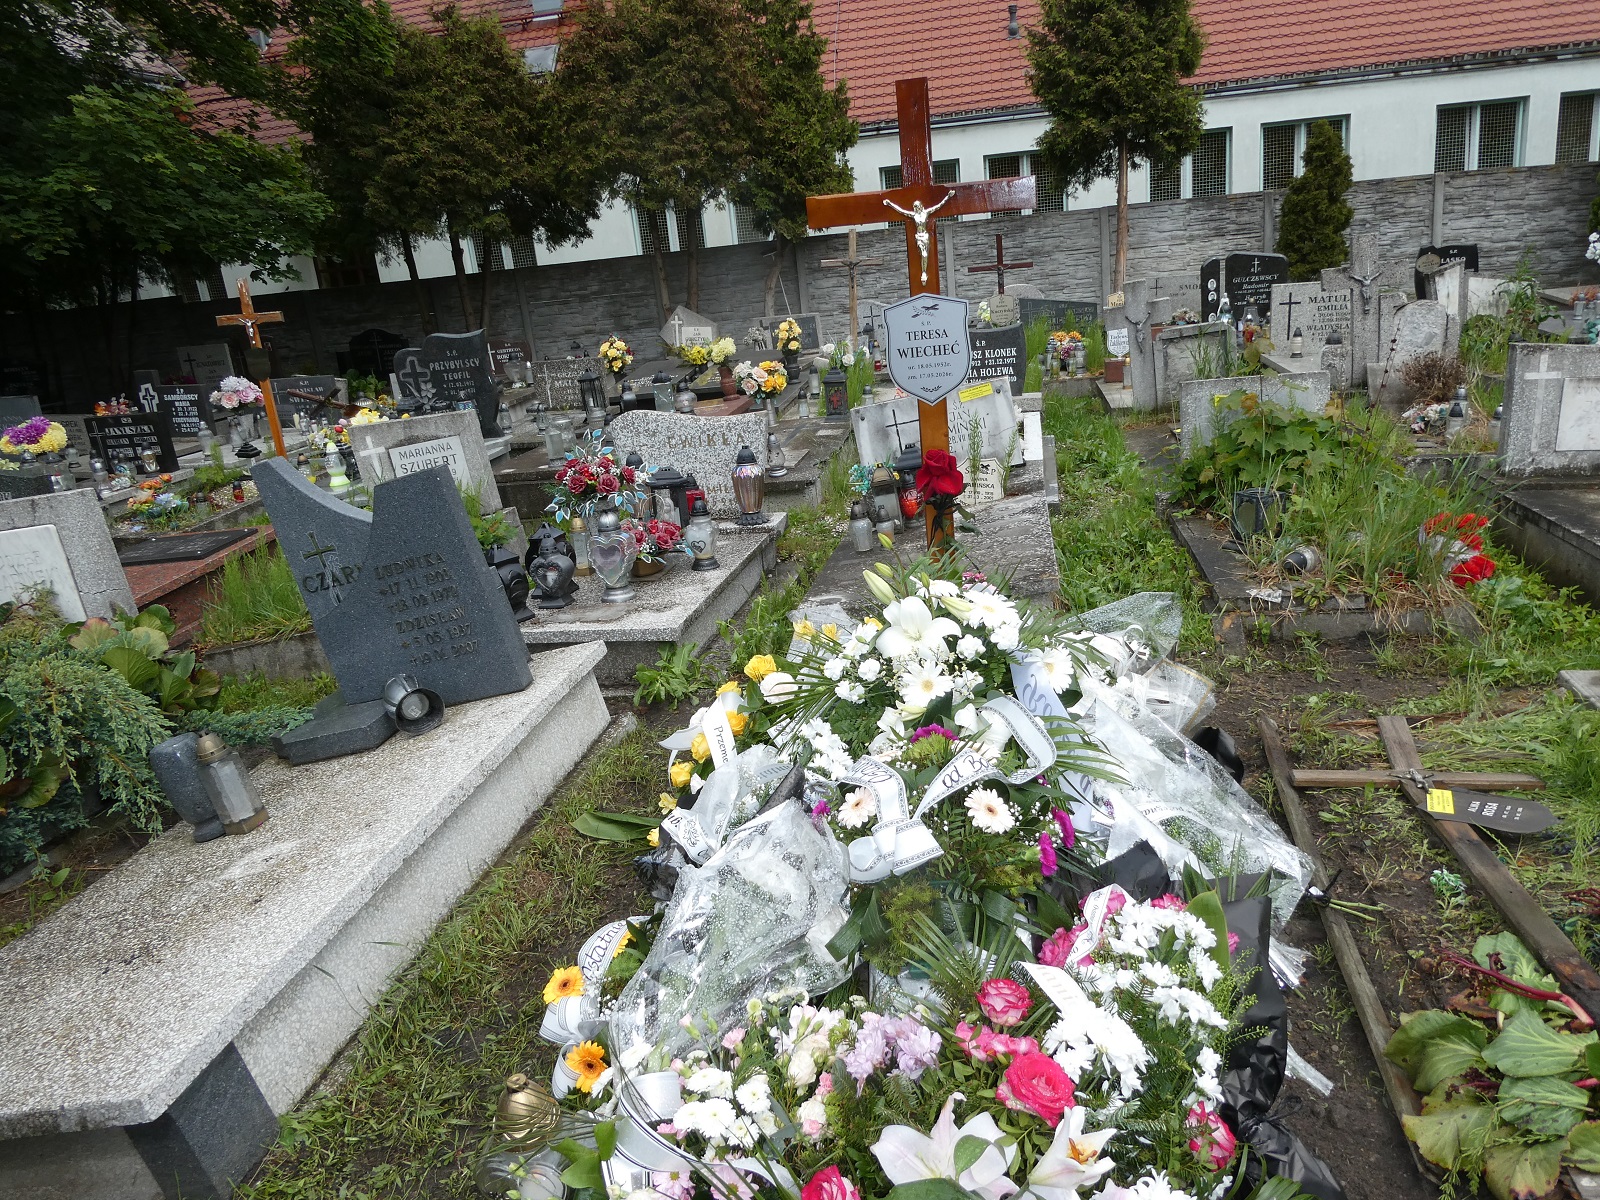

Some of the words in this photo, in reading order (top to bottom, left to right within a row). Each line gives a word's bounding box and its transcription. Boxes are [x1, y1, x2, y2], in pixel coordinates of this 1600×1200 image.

[905, 328, 949, 341] TERESA
[896, 340, 961, 359] WIECHEĆ
[985, 347, 1017, 359] KLONEK
[429, 358, 480, 371] PRZYBYLSCY
[442, 371, 471, 381] TEOFIL
[980, 366, 1014, 377] HOLEWA
[398, 441, 453, 461] MARIANNA
[400, 453, 457, 474] SZUBERT
